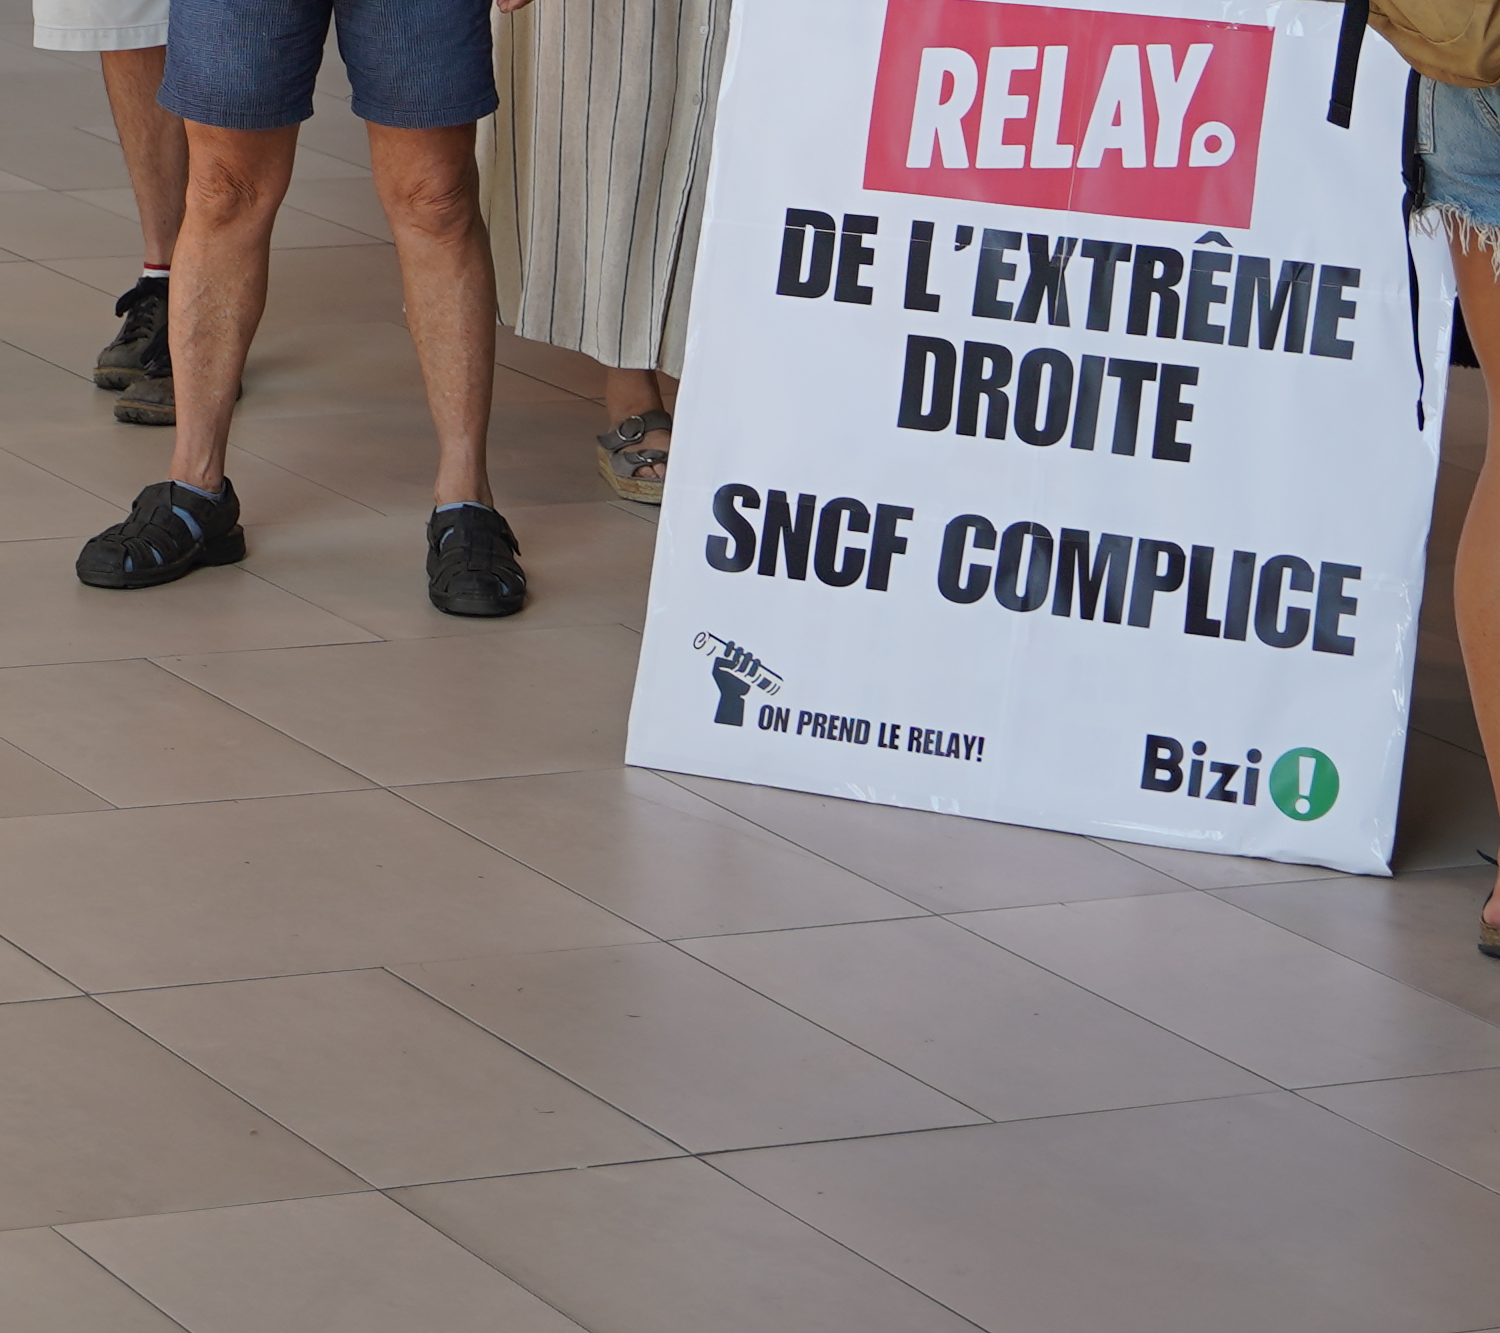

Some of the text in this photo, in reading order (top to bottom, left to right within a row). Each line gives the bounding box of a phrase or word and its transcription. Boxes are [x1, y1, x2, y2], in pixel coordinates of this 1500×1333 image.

[775, 207, 1361, 361] DE L'EXTRÊME
[895, 335, 1201, 464] DROITE
[705, 482, 1361, 658] SNCF COMPLICE
[756, 703, 985, 764] ON PREND LE RELAY!
